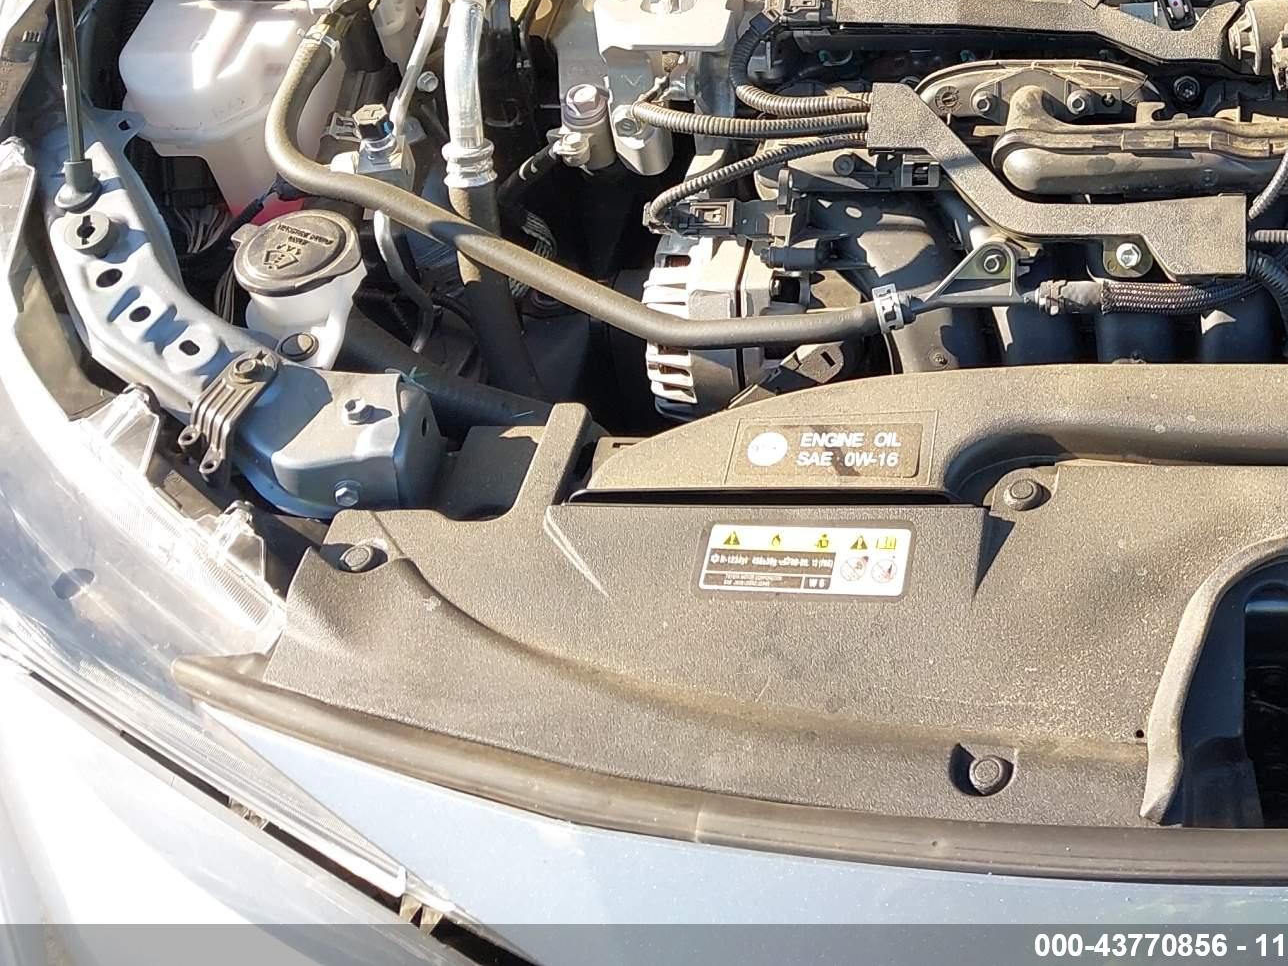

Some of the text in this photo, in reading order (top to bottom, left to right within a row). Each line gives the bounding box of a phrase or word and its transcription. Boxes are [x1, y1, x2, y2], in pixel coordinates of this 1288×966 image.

[800, 431, 902, 448] ENGINE OIL
[795, 451, 899, 467] SAE 0W-16
